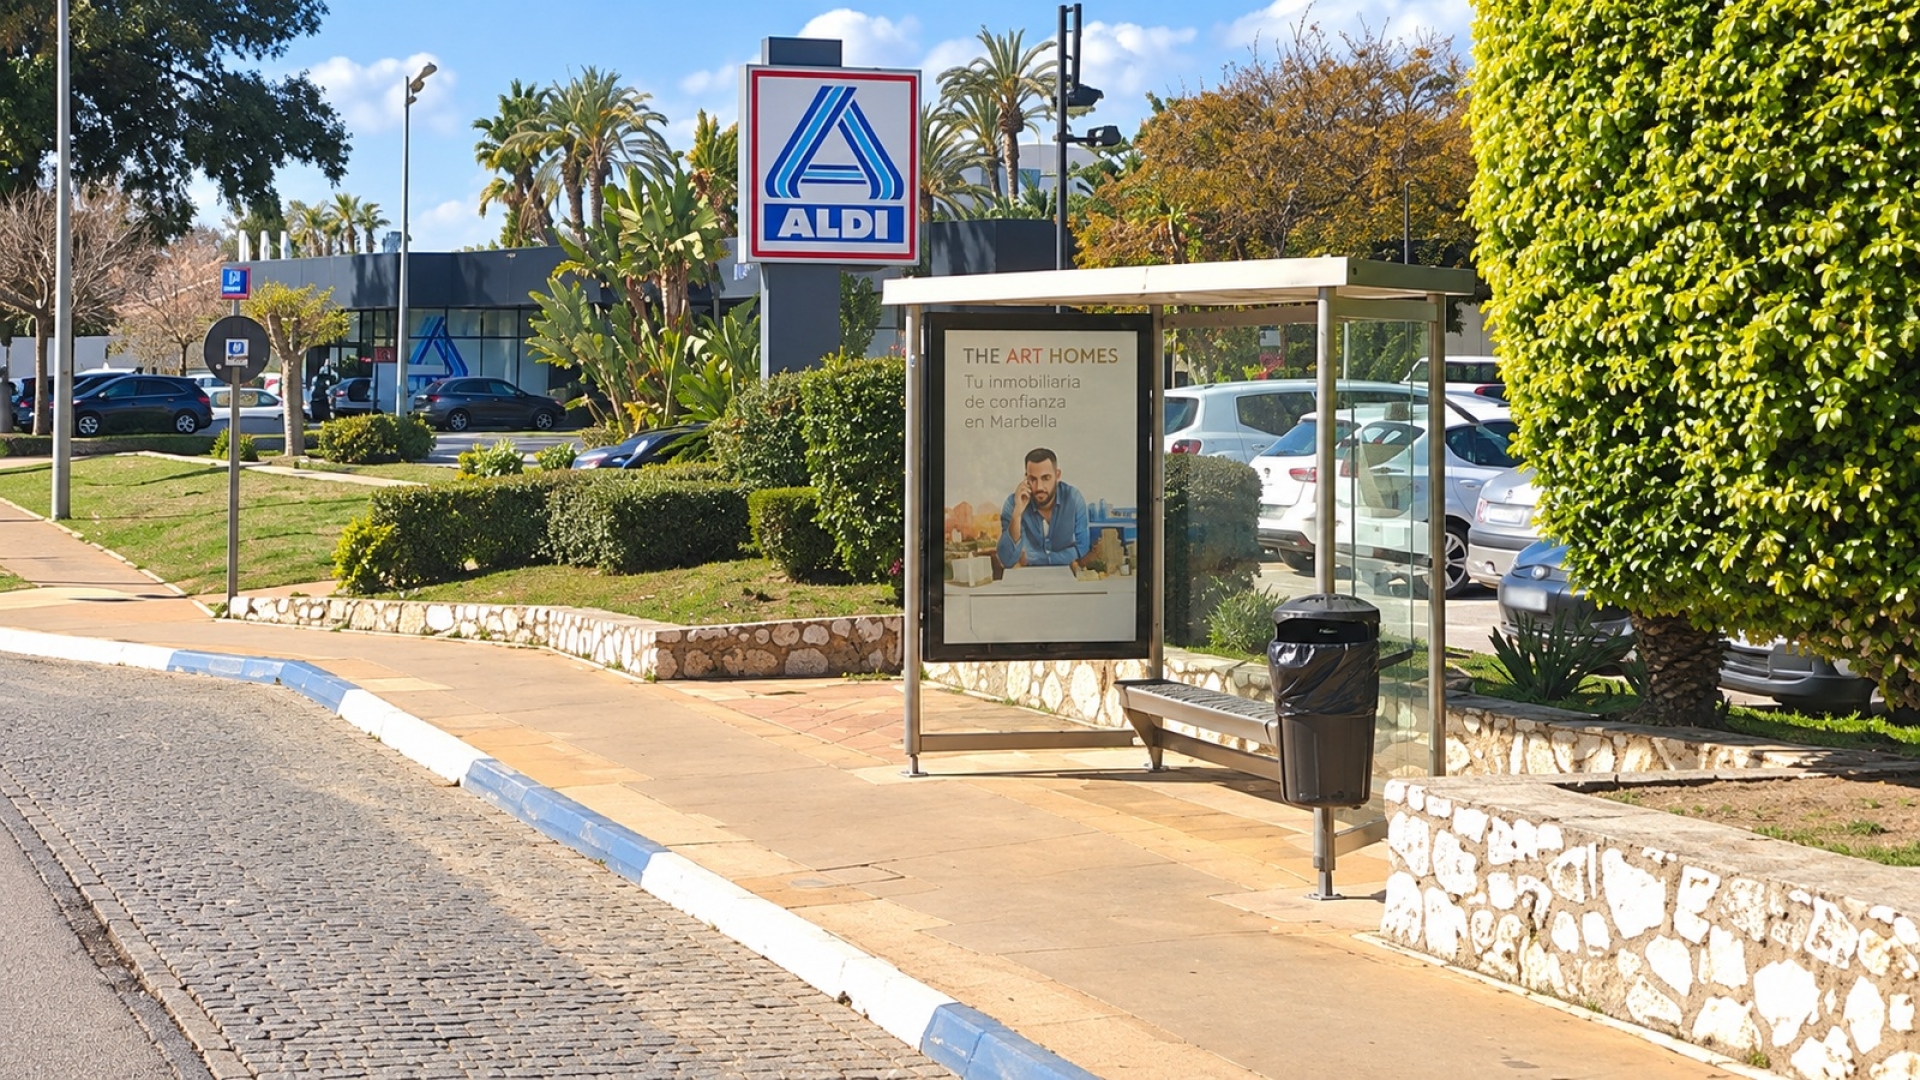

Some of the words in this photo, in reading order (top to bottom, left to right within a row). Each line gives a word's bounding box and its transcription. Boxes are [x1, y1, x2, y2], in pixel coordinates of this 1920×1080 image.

[778, 208, 889, 240] ALDI
[963, 347, 1000, 364] THE
[1006, 347, 1044, 364] ART
[1049, 347, 1119, 365] HOMES
[964, 374, 983, 389] Tu
[989, 374, 1081, 389] inmobiliaria
[964, 394, 985, 409] de
[989, 394, 1066, 409] confianza
[964, 418, 985, 429] en
[990, 414, 1057, 429] Marbella
